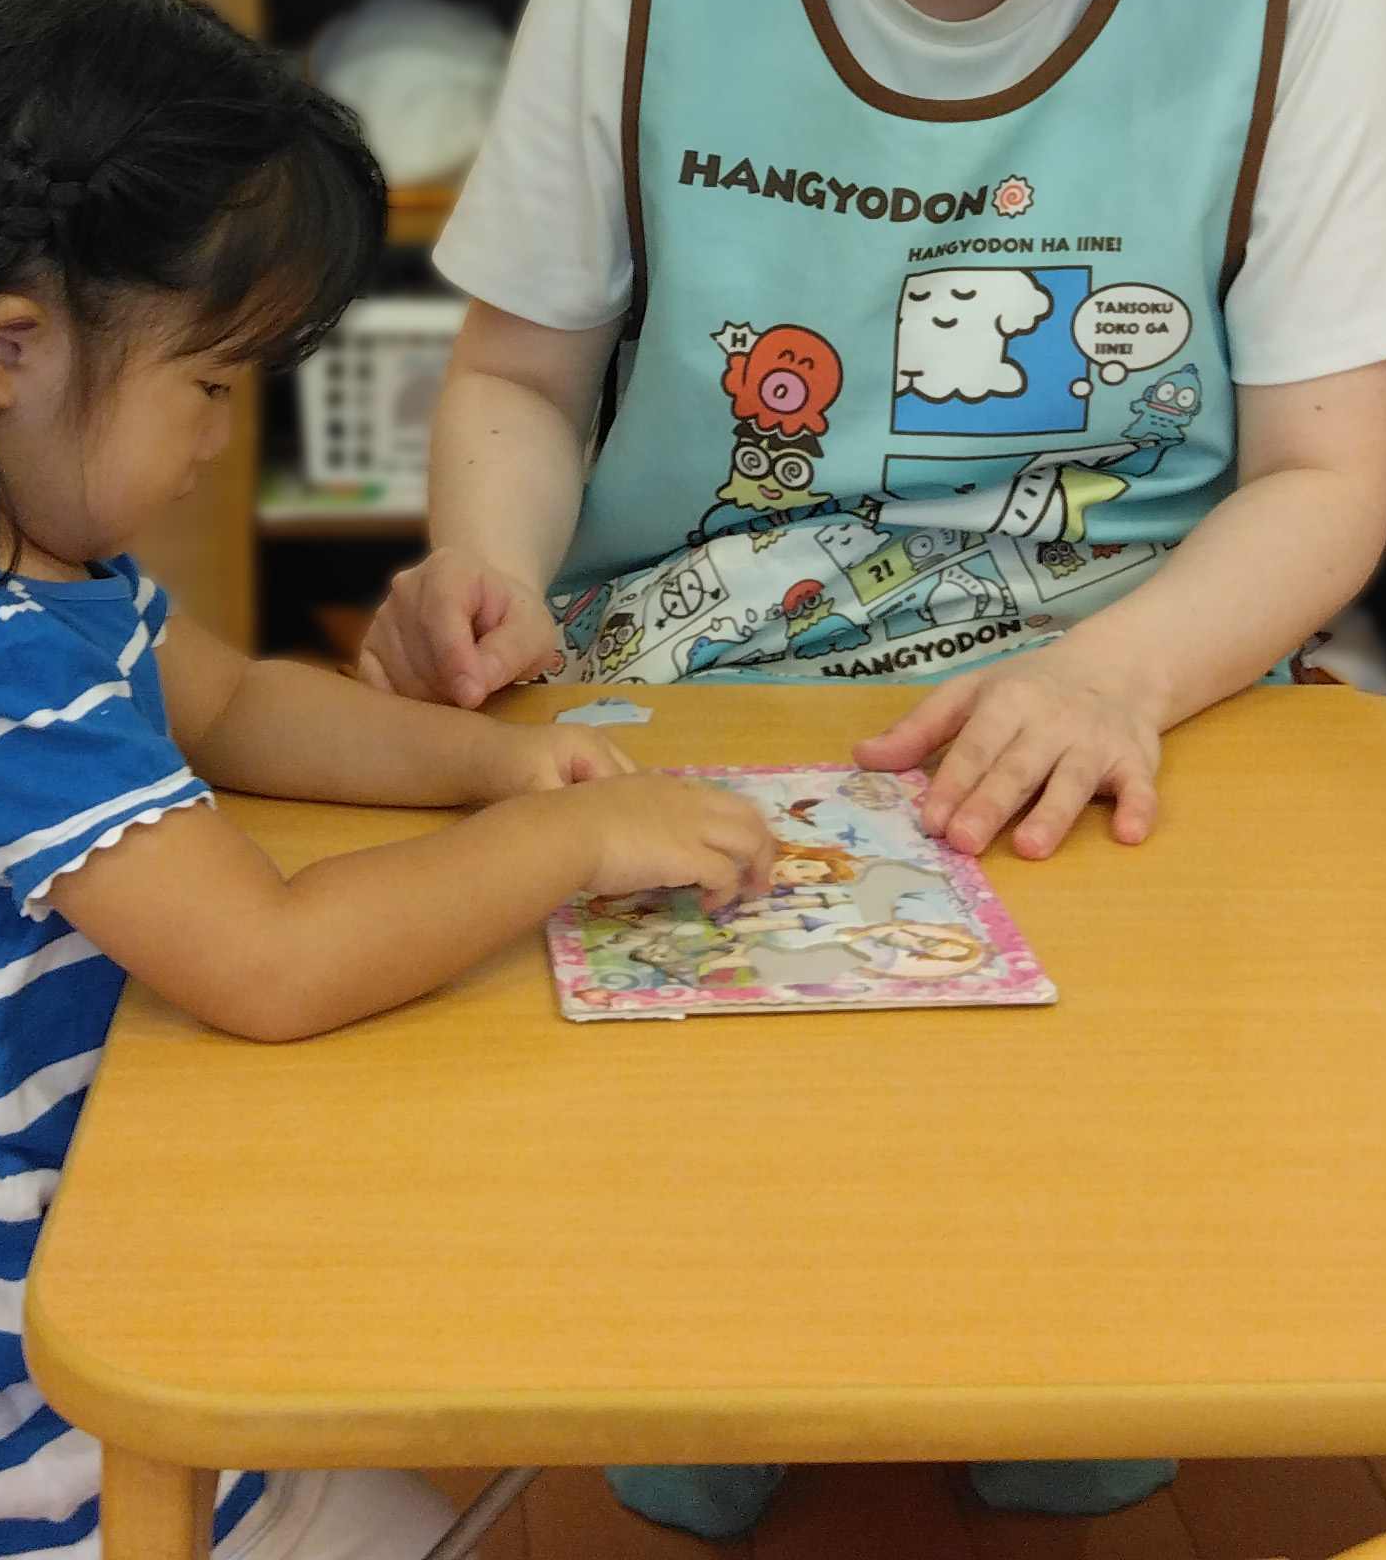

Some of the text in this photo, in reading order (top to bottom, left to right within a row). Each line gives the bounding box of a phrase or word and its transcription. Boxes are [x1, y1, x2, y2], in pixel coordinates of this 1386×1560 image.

[678, 149, 989, 225] HANGYODON
[907, 236, 1122, 262] HANGYODON HA IINE!
[1094, 300, 1174, 315] TANSOKU
[1094, 321, 1170, 335] SOKO GA
[730, 332, 748, 348] H
